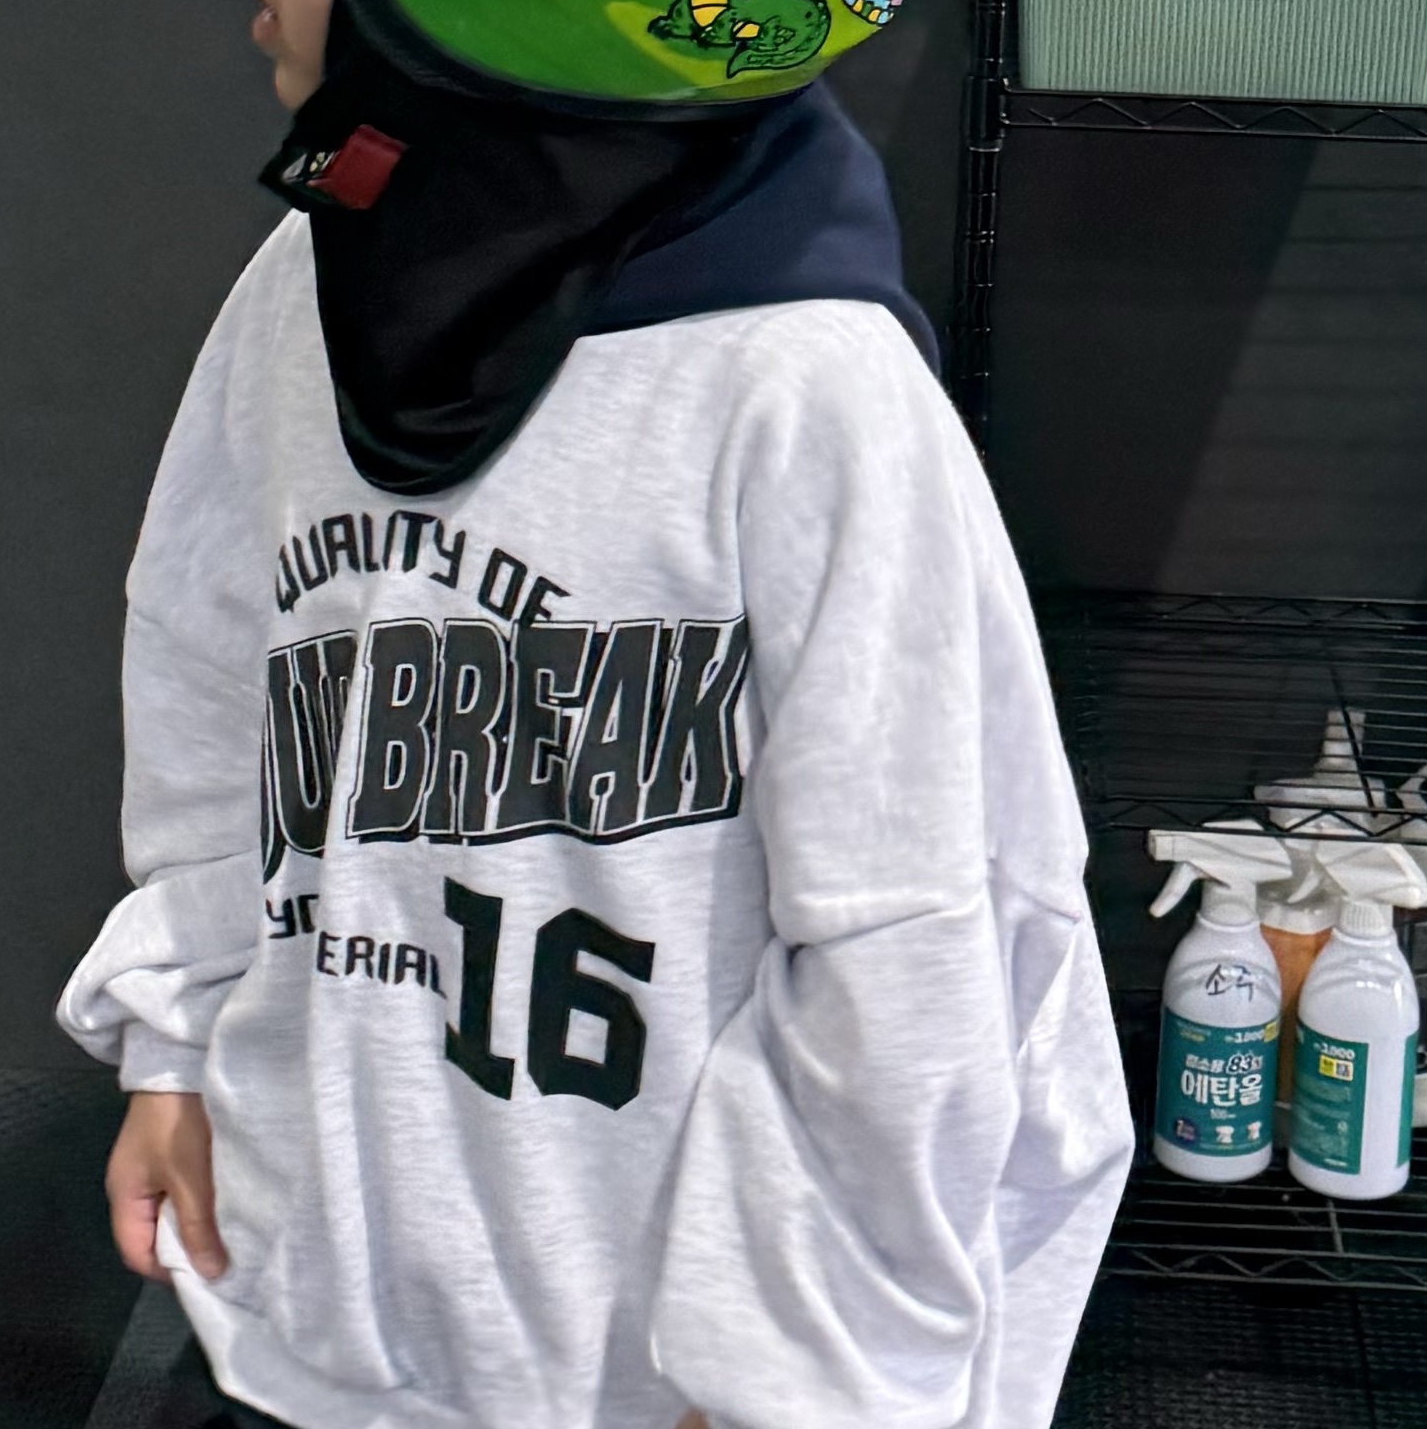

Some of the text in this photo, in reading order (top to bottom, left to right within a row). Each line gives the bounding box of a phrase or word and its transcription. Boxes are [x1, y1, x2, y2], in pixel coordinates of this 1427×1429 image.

[275, 509, 572, 628] QUALITY OF
[260, 616, 750, 885] UTBREAK
[444, 875, 656, 1111] 16
[1181, 1070, 1263, 1106] 에탄올
